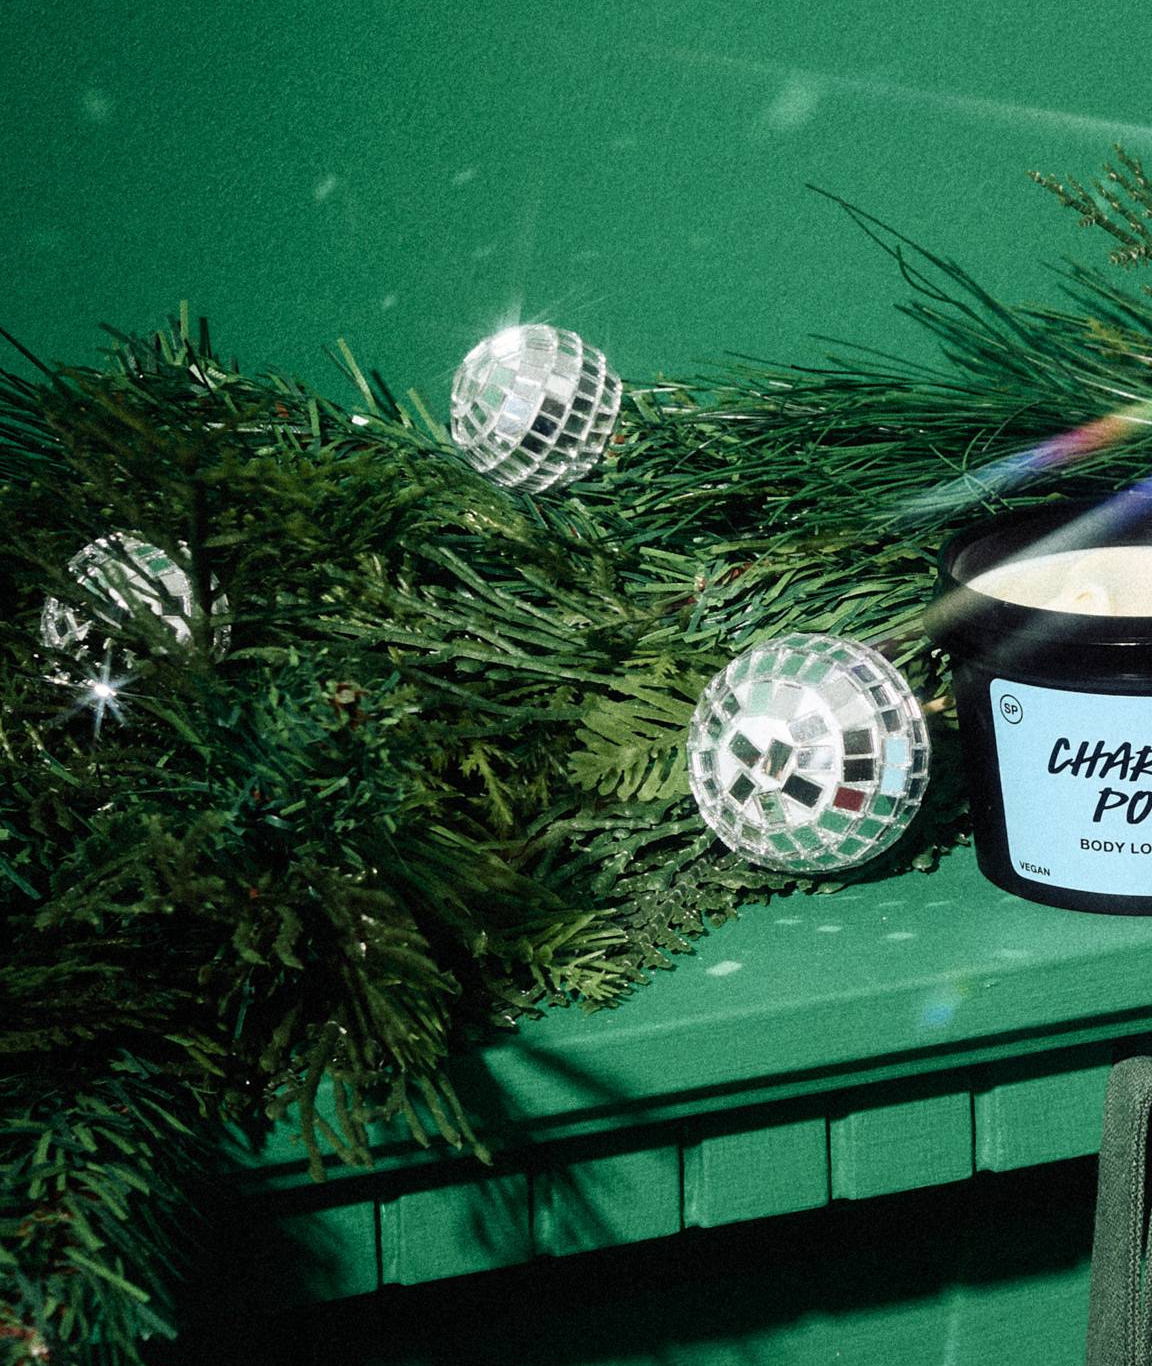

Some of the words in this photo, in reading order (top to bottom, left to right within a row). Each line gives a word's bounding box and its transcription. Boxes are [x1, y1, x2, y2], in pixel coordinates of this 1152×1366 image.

[1003, 702, 1019, 716] SP
[1080, 838, 1125, 854] BODY
[1019, 860, 1051, 876] VEGAN
